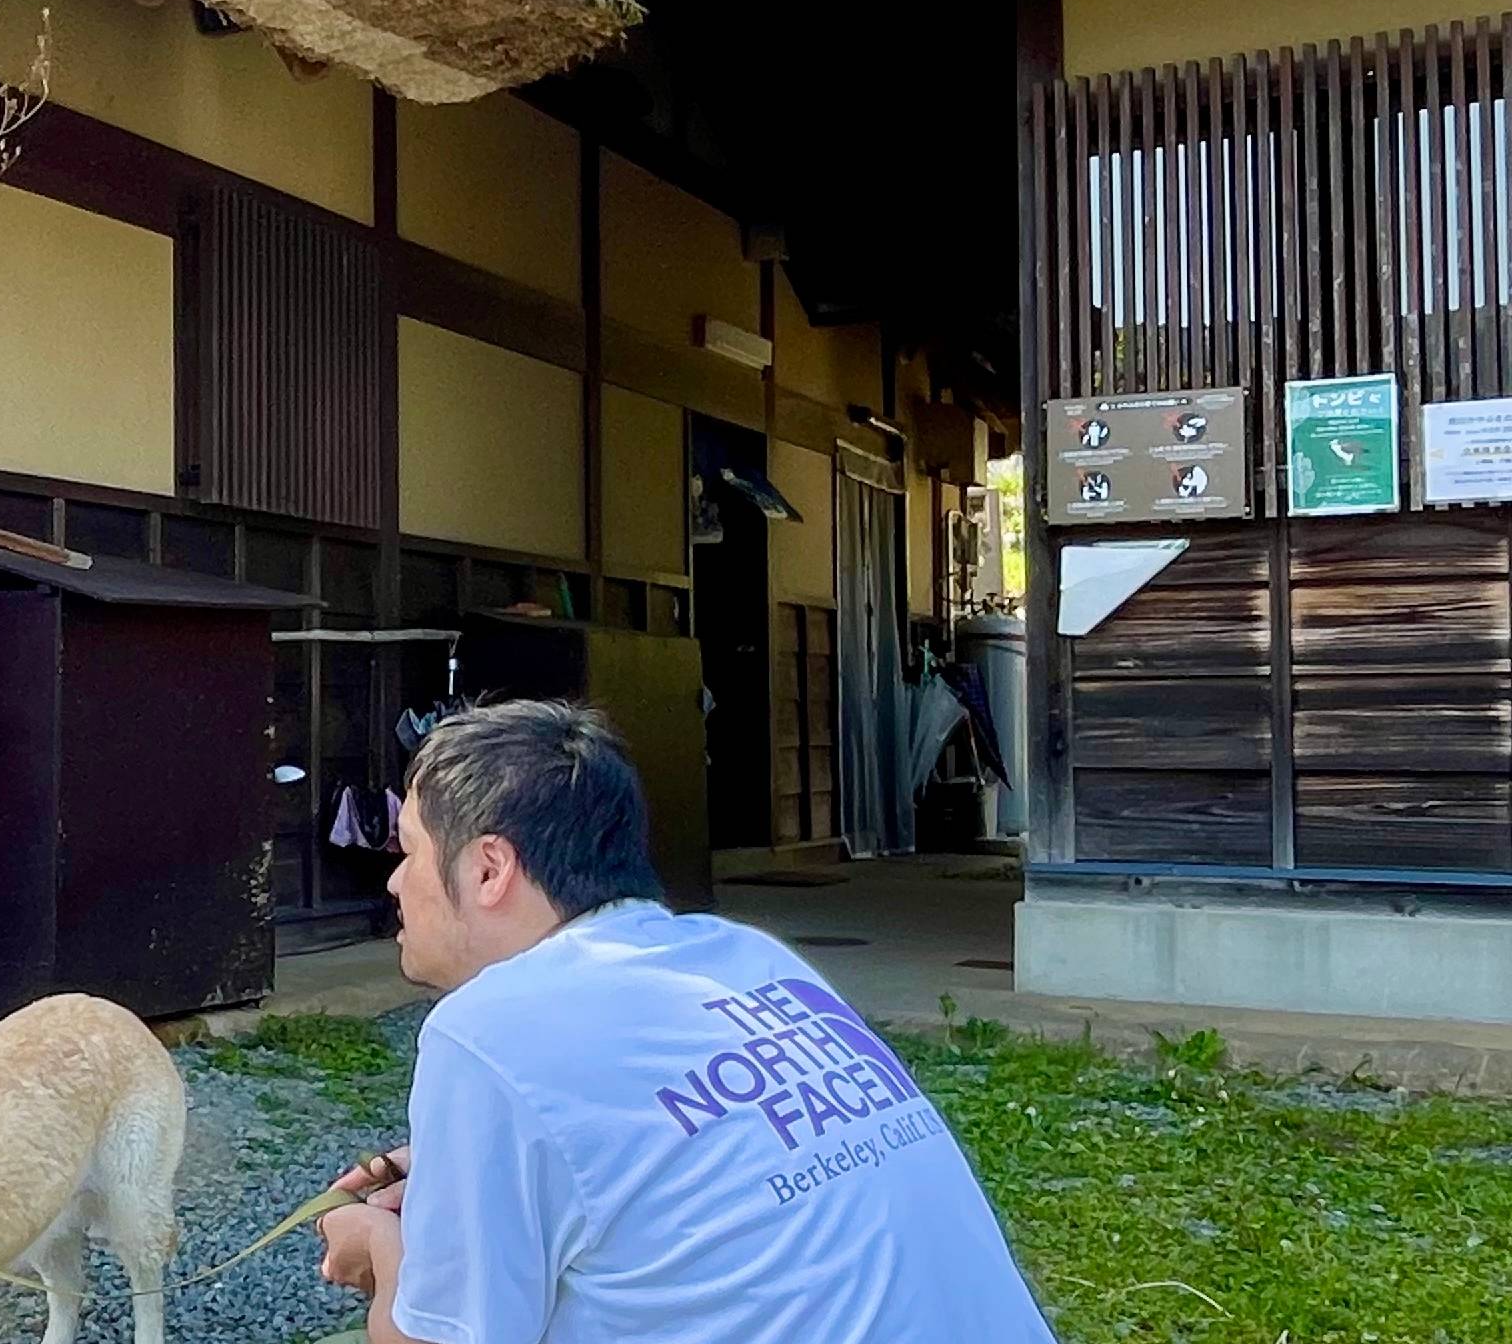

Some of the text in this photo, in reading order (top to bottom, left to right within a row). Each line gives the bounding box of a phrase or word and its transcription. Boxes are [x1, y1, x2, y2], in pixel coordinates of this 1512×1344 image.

[702, 982, 811, 1035] THE
[656, 1018, 858, 1137] NORTH
[758, 1062, 894, 1151] FACE
[766, 1137, 886, 1205] Berkeley,
